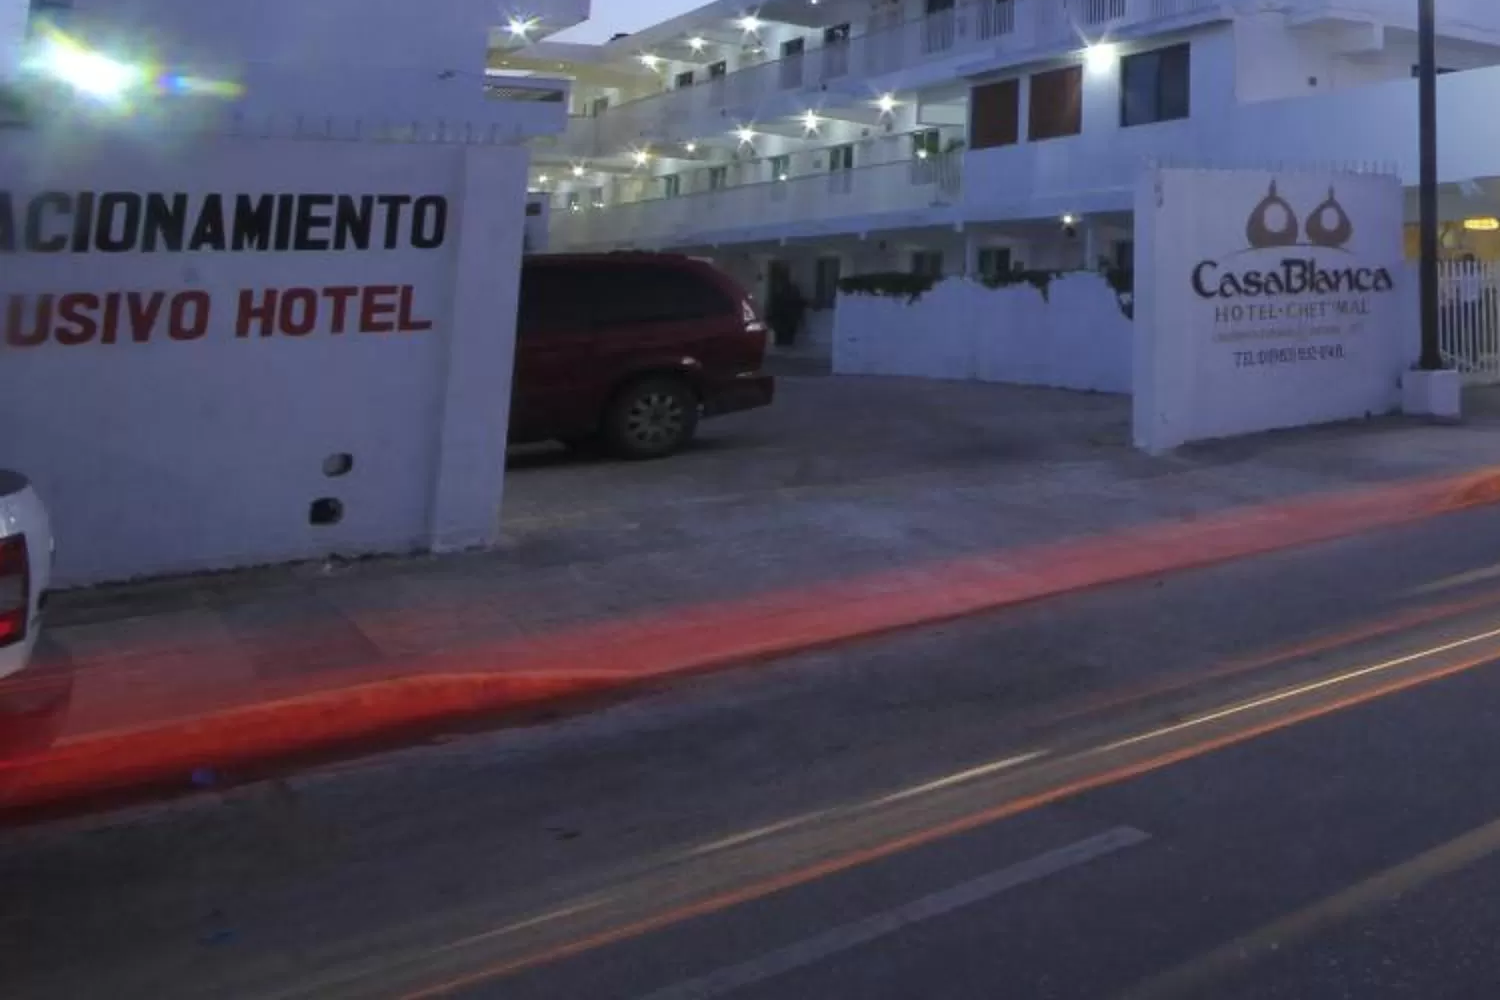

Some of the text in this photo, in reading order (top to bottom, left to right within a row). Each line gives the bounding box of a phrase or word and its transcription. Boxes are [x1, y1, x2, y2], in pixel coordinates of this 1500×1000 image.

[1191, 257, 1393, 298] CasaBlanca
[6, 285, 432, 347] USIVO HOTEL
